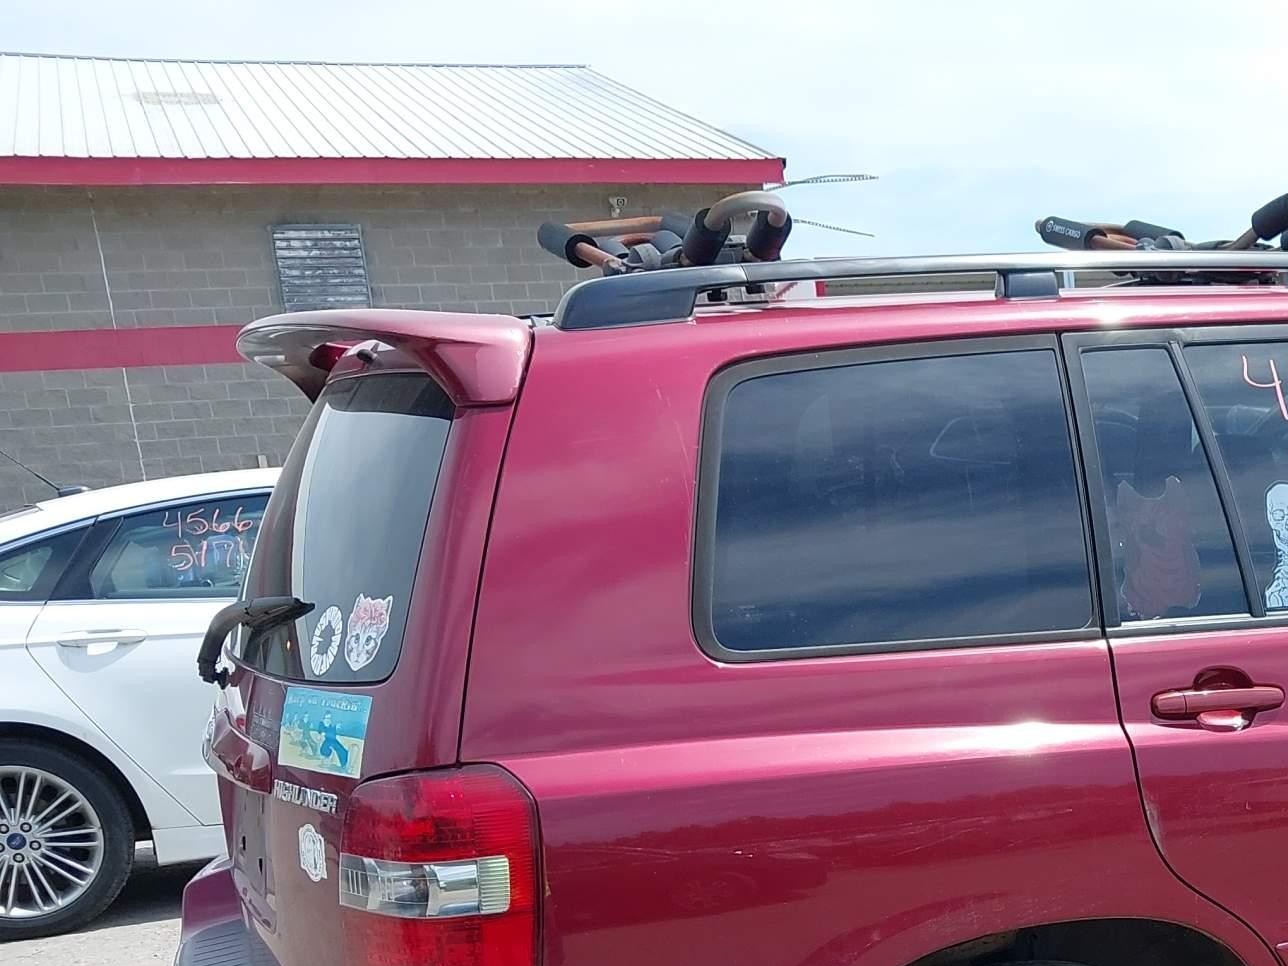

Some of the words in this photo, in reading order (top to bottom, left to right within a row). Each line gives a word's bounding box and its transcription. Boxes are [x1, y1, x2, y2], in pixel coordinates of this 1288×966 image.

[1065, 227, 1080, 239] CARGO
[162, 506, 253, 538] 4566
[273, 778, 338, 815] HIGHLANDER
